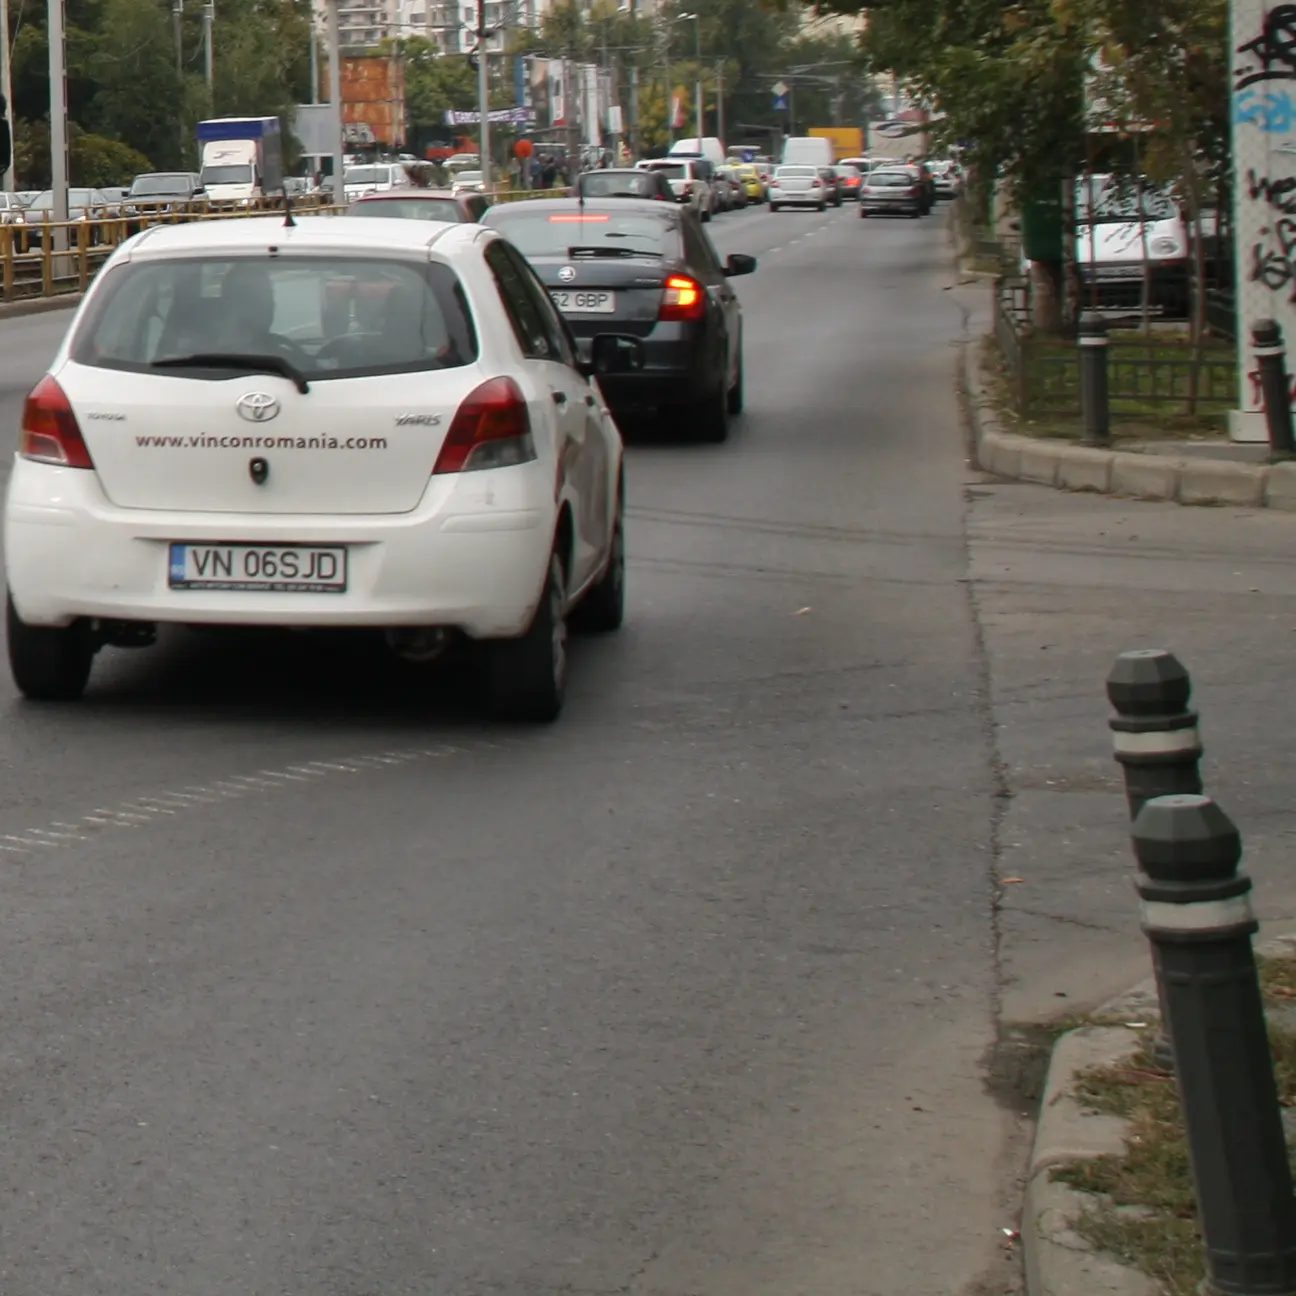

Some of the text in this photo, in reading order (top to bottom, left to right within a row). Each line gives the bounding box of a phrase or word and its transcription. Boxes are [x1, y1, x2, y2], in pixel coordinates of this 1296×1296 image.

[575, 293, 609, 308] GBP
[393, 413, 443, 427] YARIS
[135, 432, 388, 451] www.vinconromania.com
[192, 549, 338, 580] VN 06SJD
